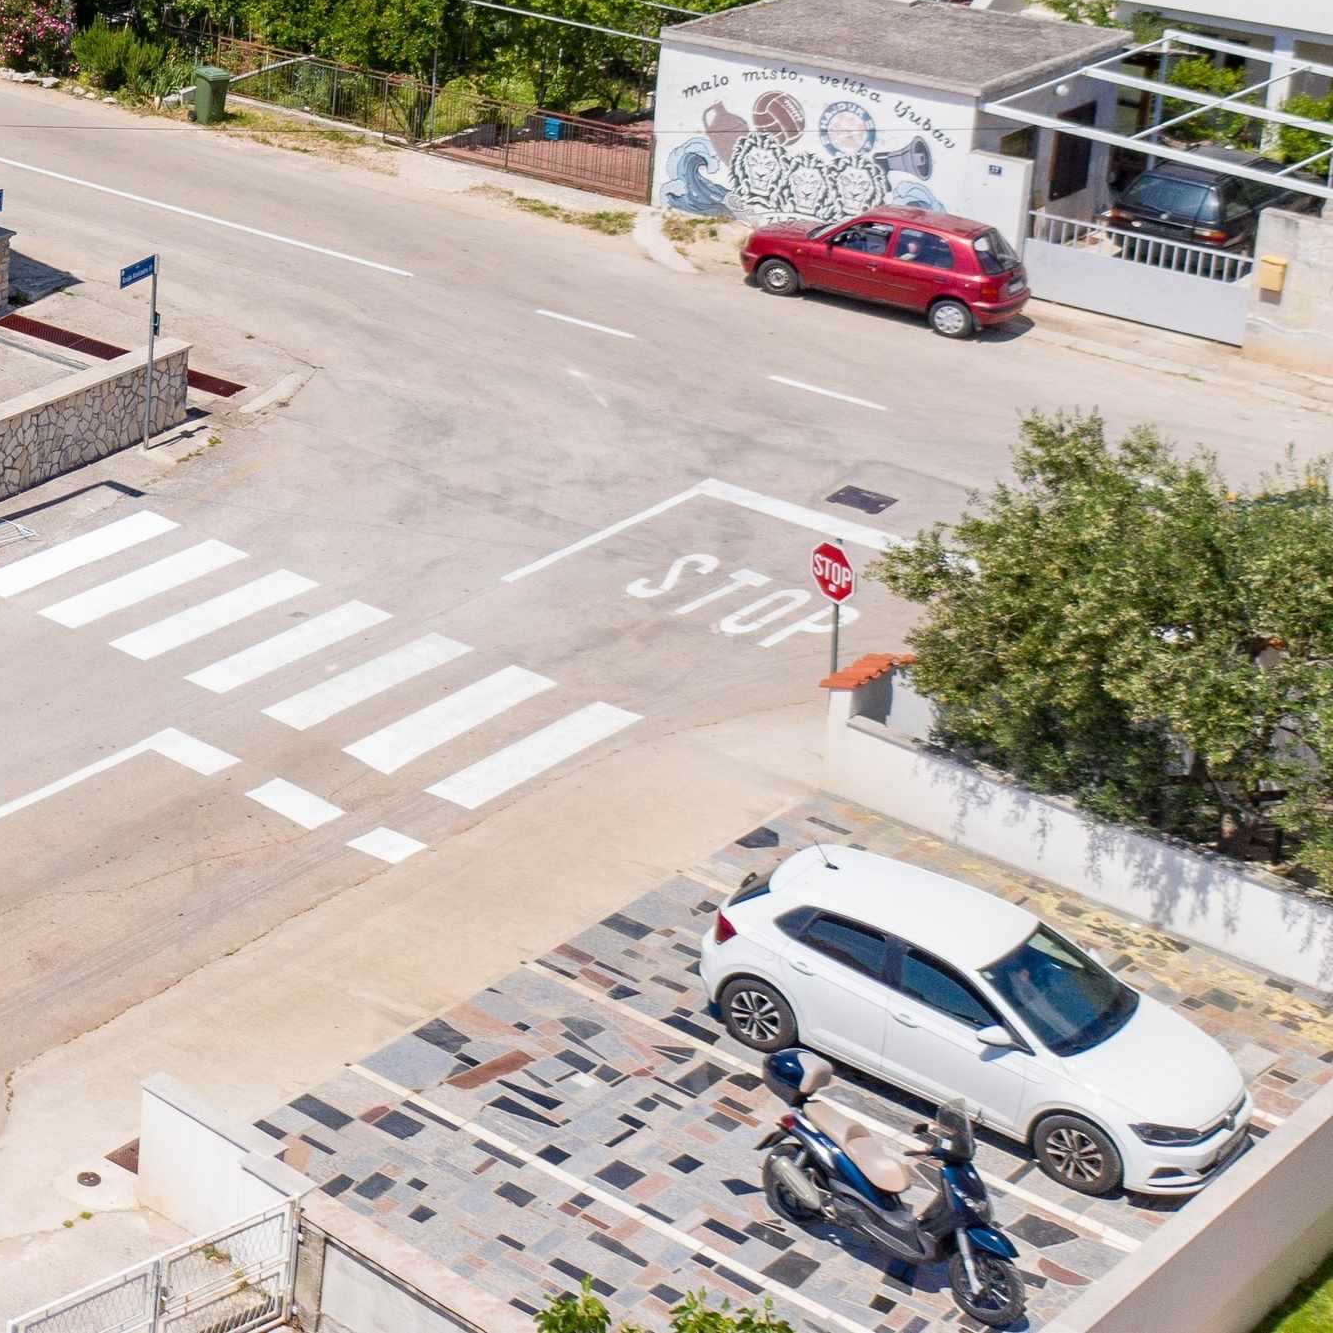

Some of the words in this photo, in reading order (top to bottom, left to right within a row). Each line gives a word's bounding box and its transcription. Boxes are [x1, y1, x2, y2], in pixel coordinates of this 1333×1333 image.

[682, 74, 730, 99] malo
[742, 67, 804, 83] misto,
[819, 74, 882, 104] velika
[893, 99, 956, 149] ljubav
[625, 553, 860, 648] STOP
[814, 553, 851, 588] STOP
